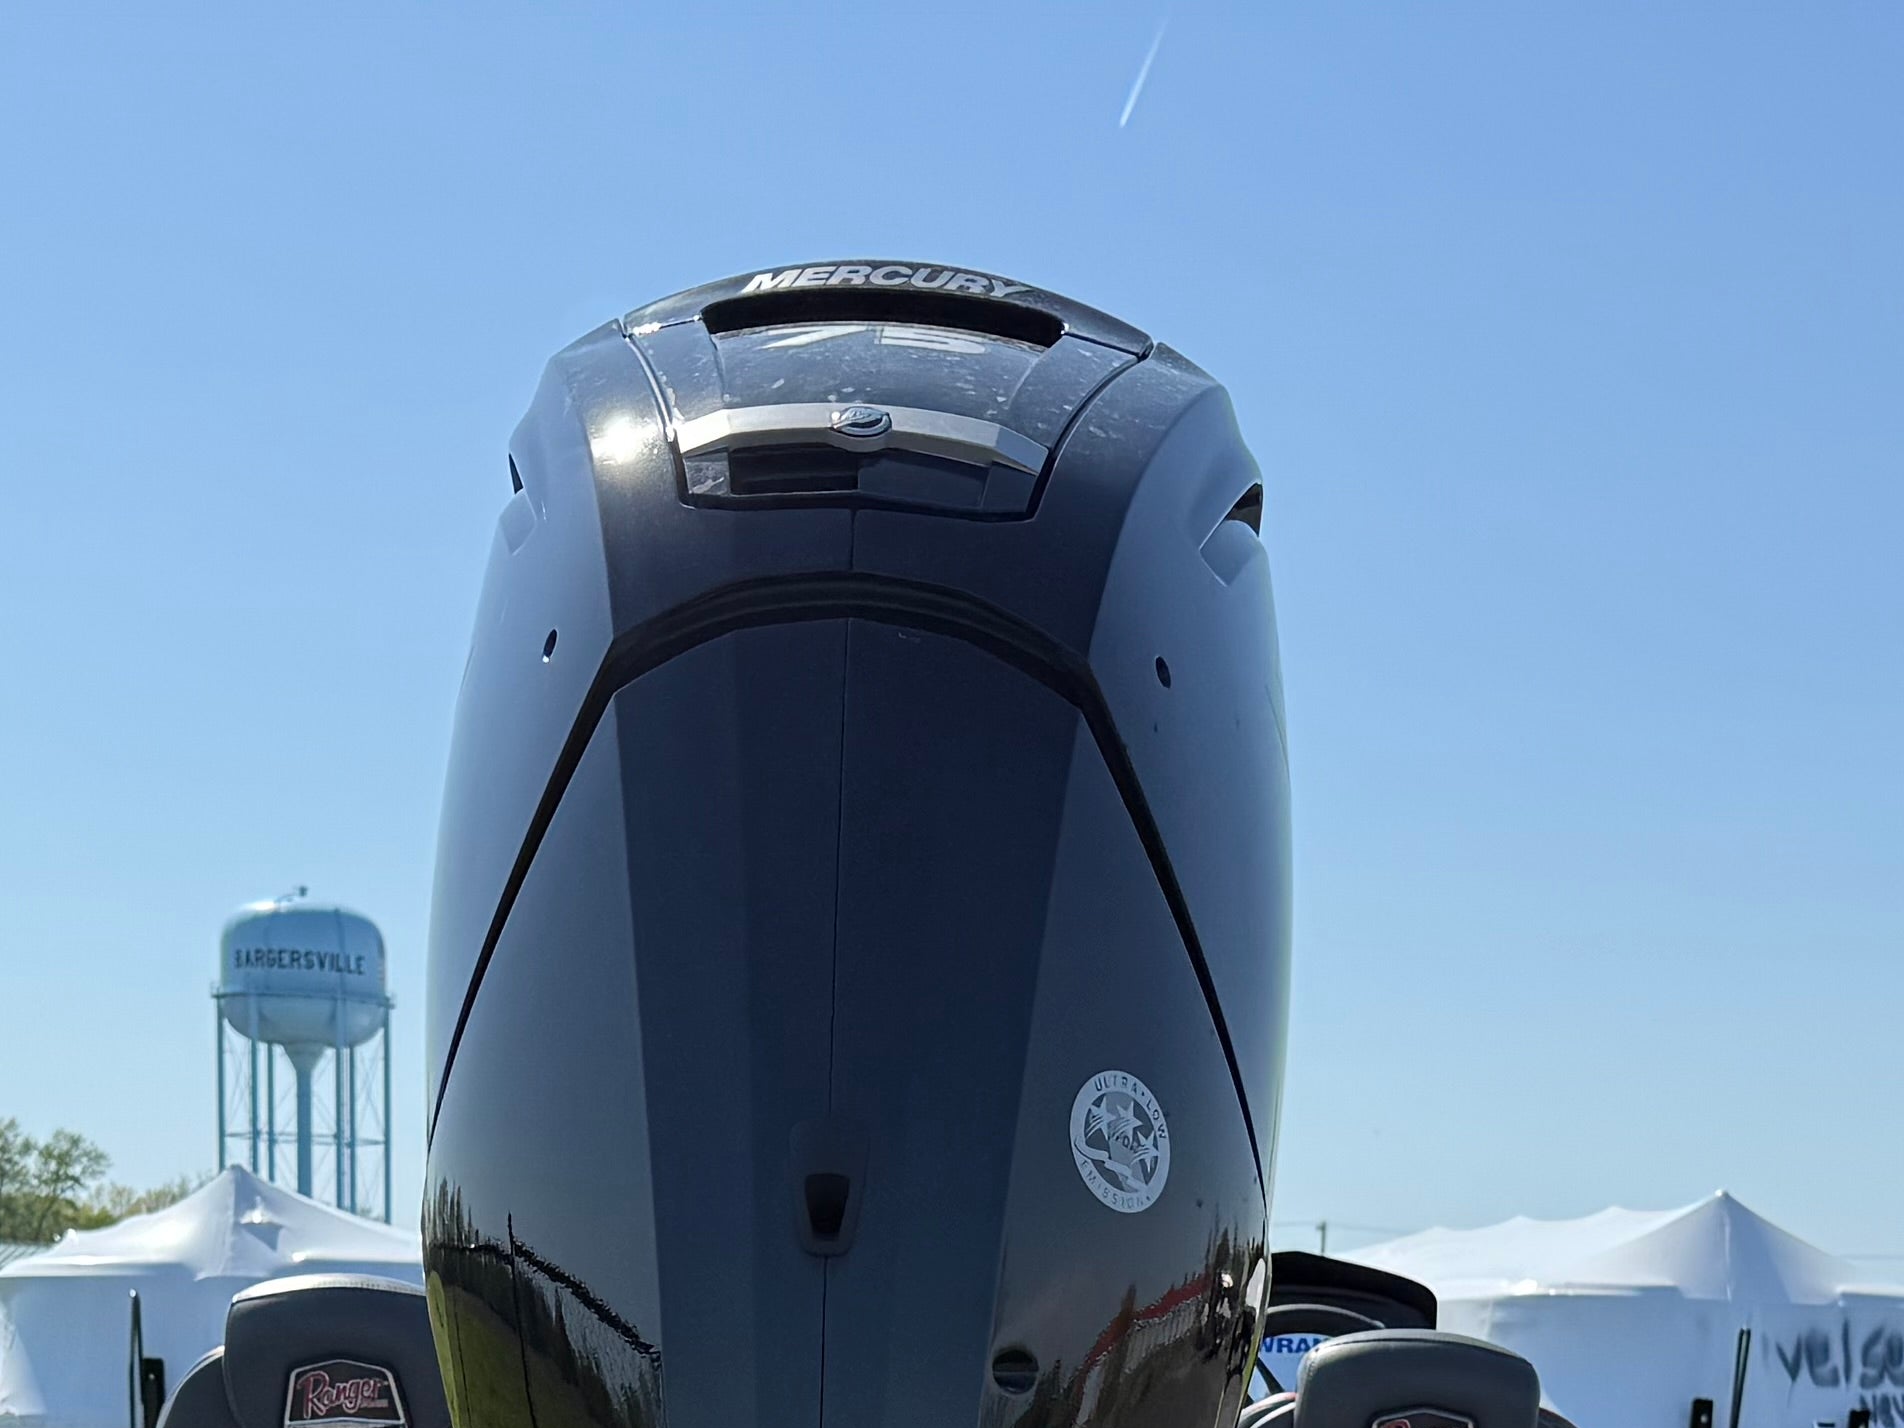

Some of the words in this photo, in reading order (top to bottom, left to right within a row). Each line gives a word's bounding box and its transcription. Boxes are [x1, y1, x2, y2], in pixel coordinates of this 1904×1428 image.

[739, 265, 1034, 297] MERCURY
[234, 949, 366, 975] BARGERSVILLE
[296, 1370, 383, 1419] Ranger
